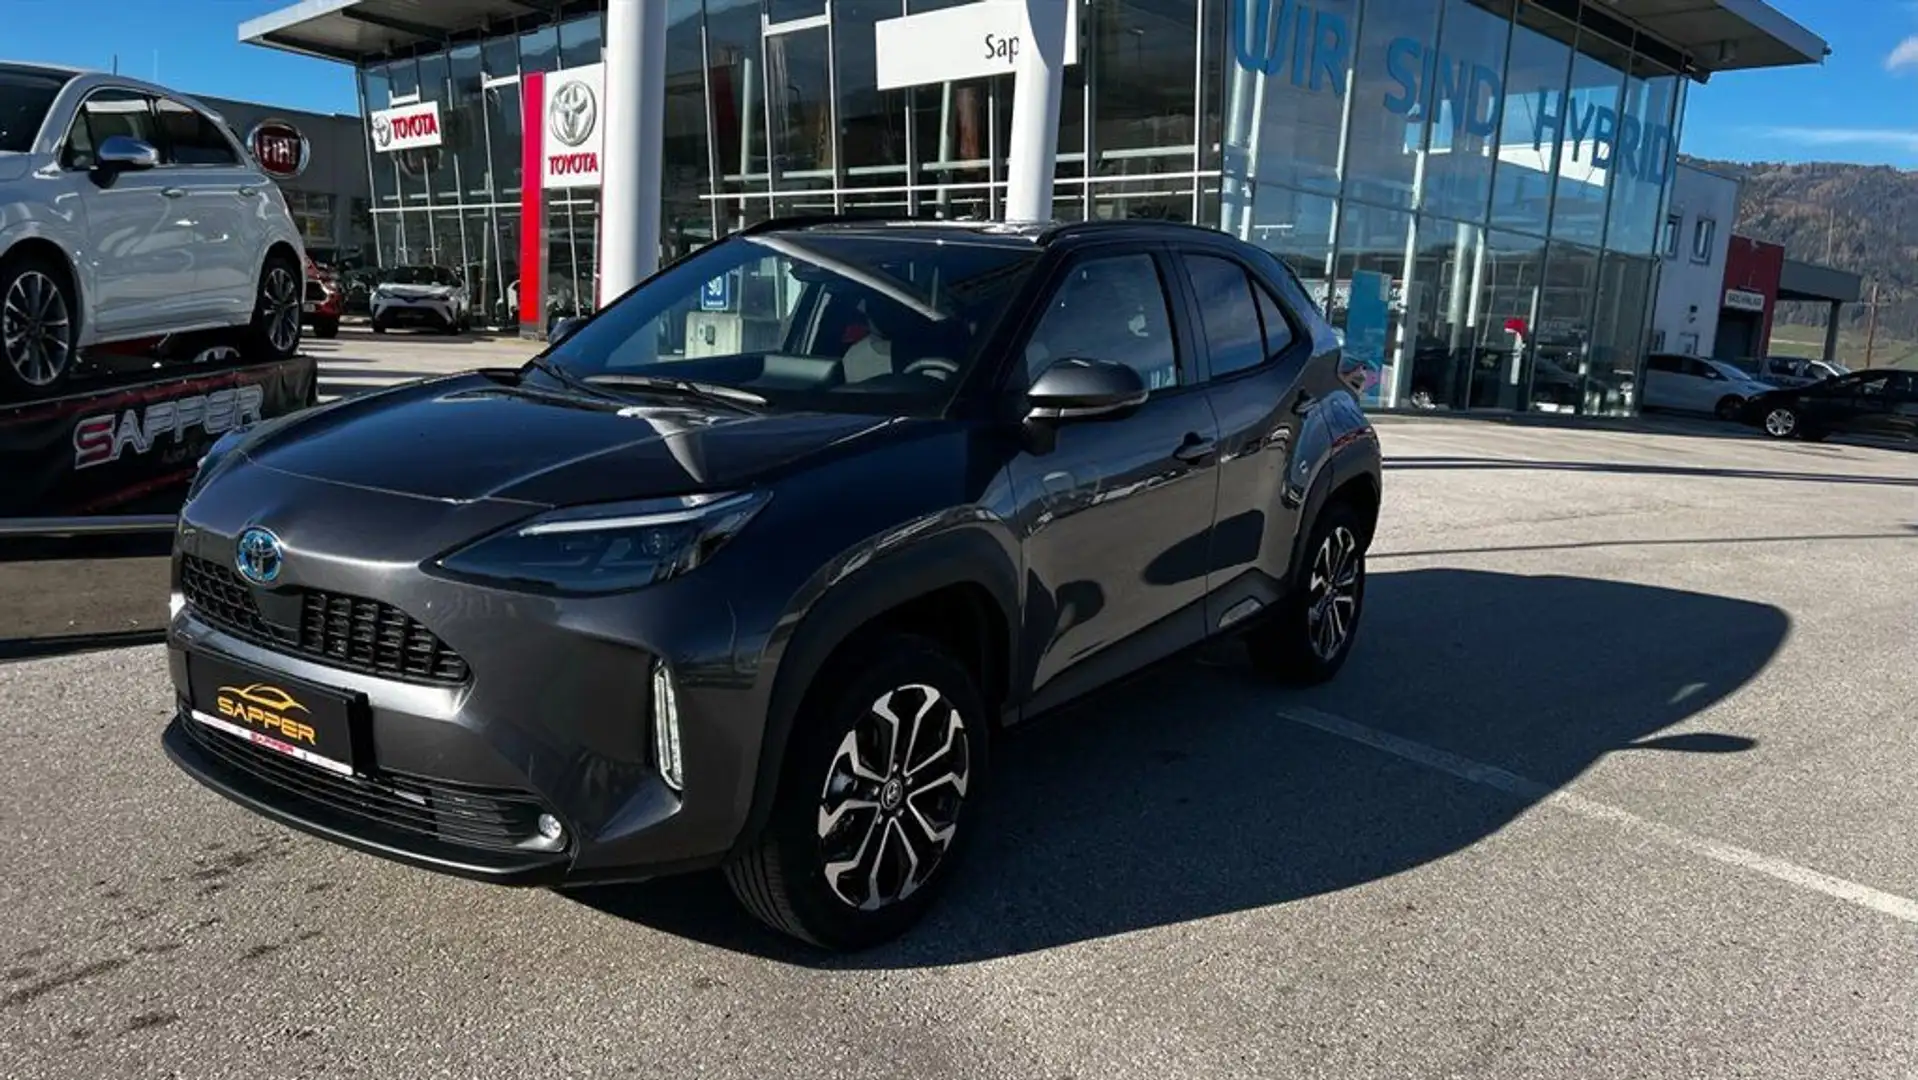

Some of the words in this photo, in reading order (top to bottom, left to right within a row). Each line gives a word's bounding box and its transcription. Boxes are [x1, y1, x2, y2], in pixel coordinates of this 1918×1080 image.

[1233, 0, 1349, 97] WIR
[1384, 37, 1501, 137] SIND
[1533, 86, 1677, 185] HYBRID
[391, 113, 438, 140] TOYOTA
[262, 135, 299, 164] FIAT
[548, 152, 599, 176] TOYOTA
[73, 384, 264, 470] SAPPER
[217, 696, 316, 746] SAPPER
